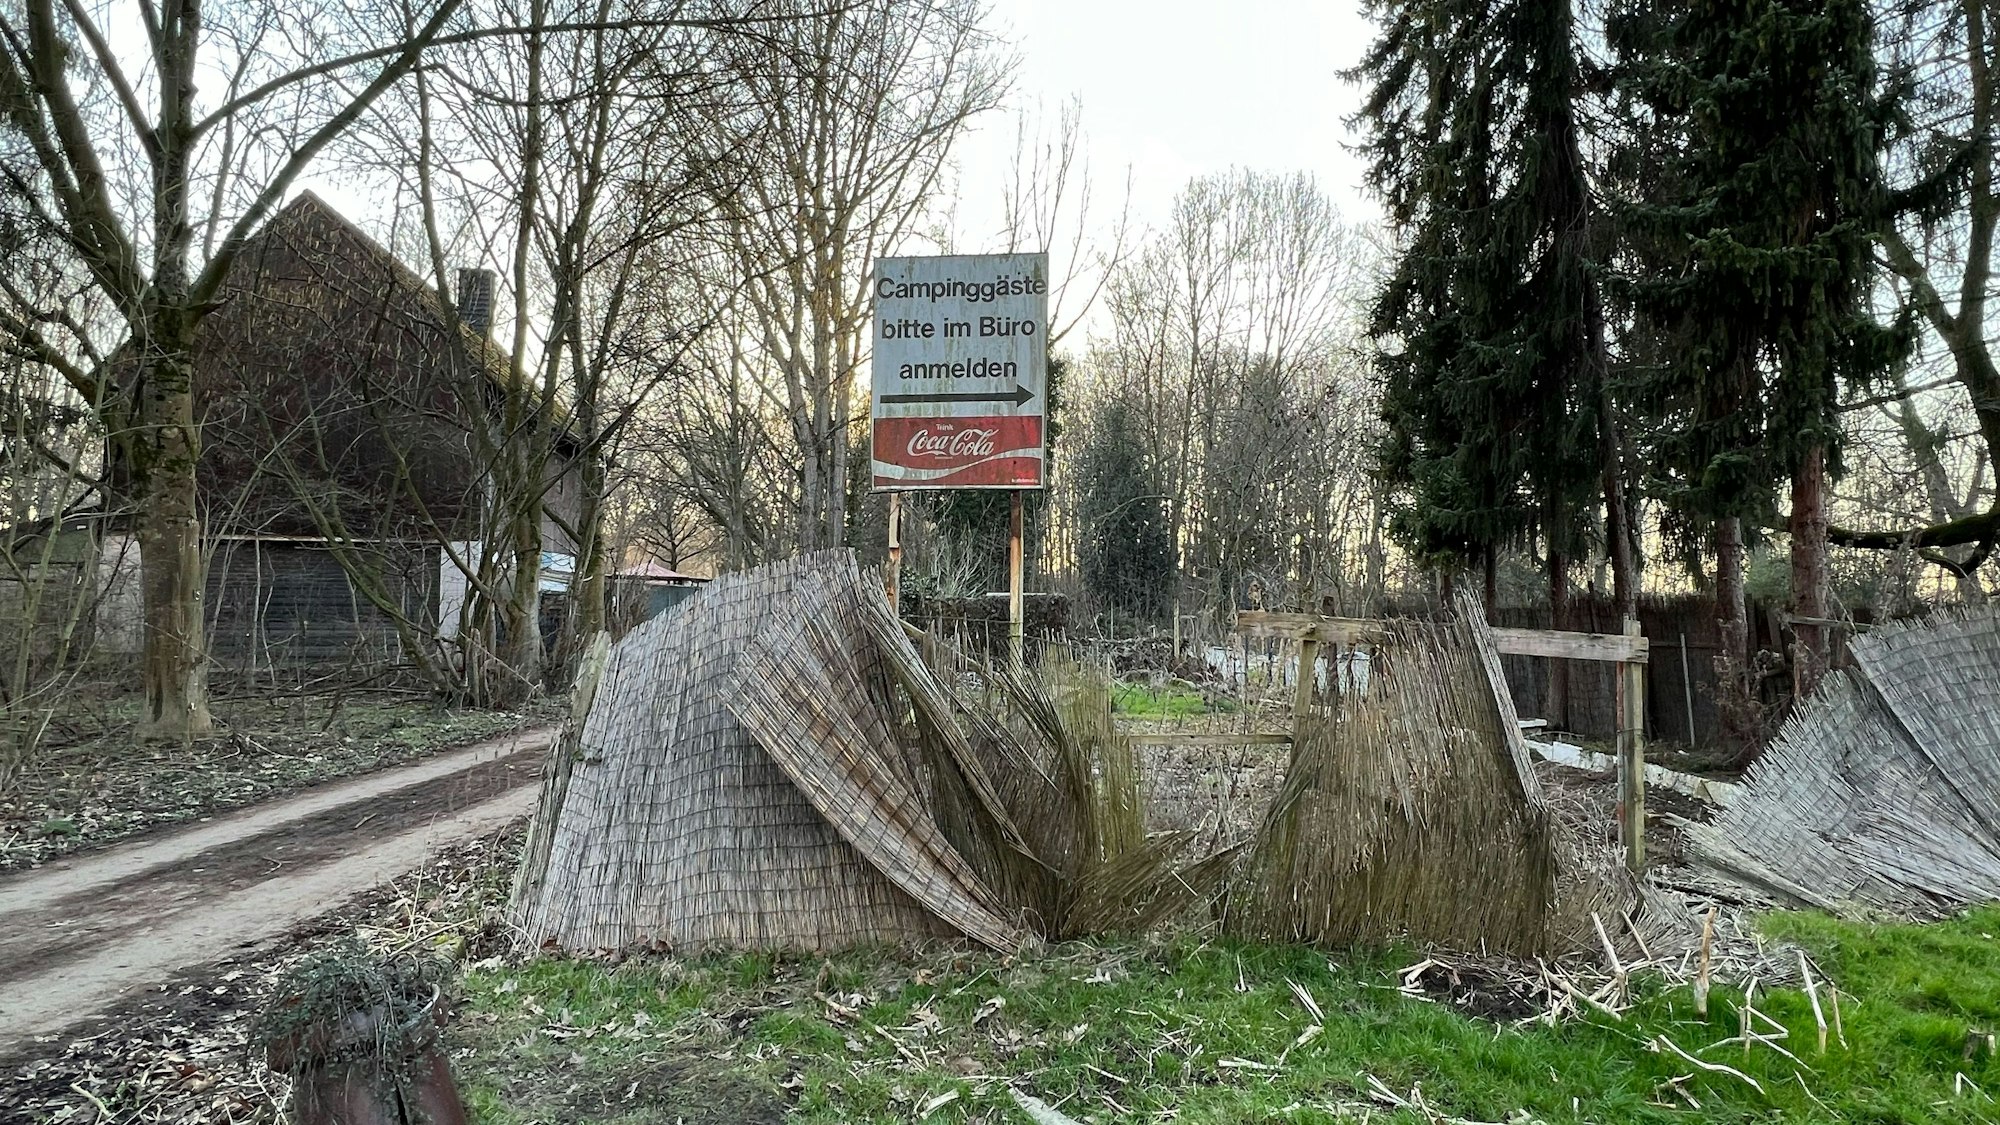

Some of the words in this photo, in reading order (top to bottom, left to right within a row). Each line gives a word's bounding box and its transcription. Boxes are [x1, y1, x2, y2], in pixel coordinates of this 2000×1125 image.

[876, 274, 1047, 303] Campinggäste
[881, 318, 935, 339] bitte
[943, 317, 971, 337] im
[979, 316, 1036, 337] Büro
[899, 357, 1017, 379] anmelden
[907, 429, 999, 456] Coca-Cola
